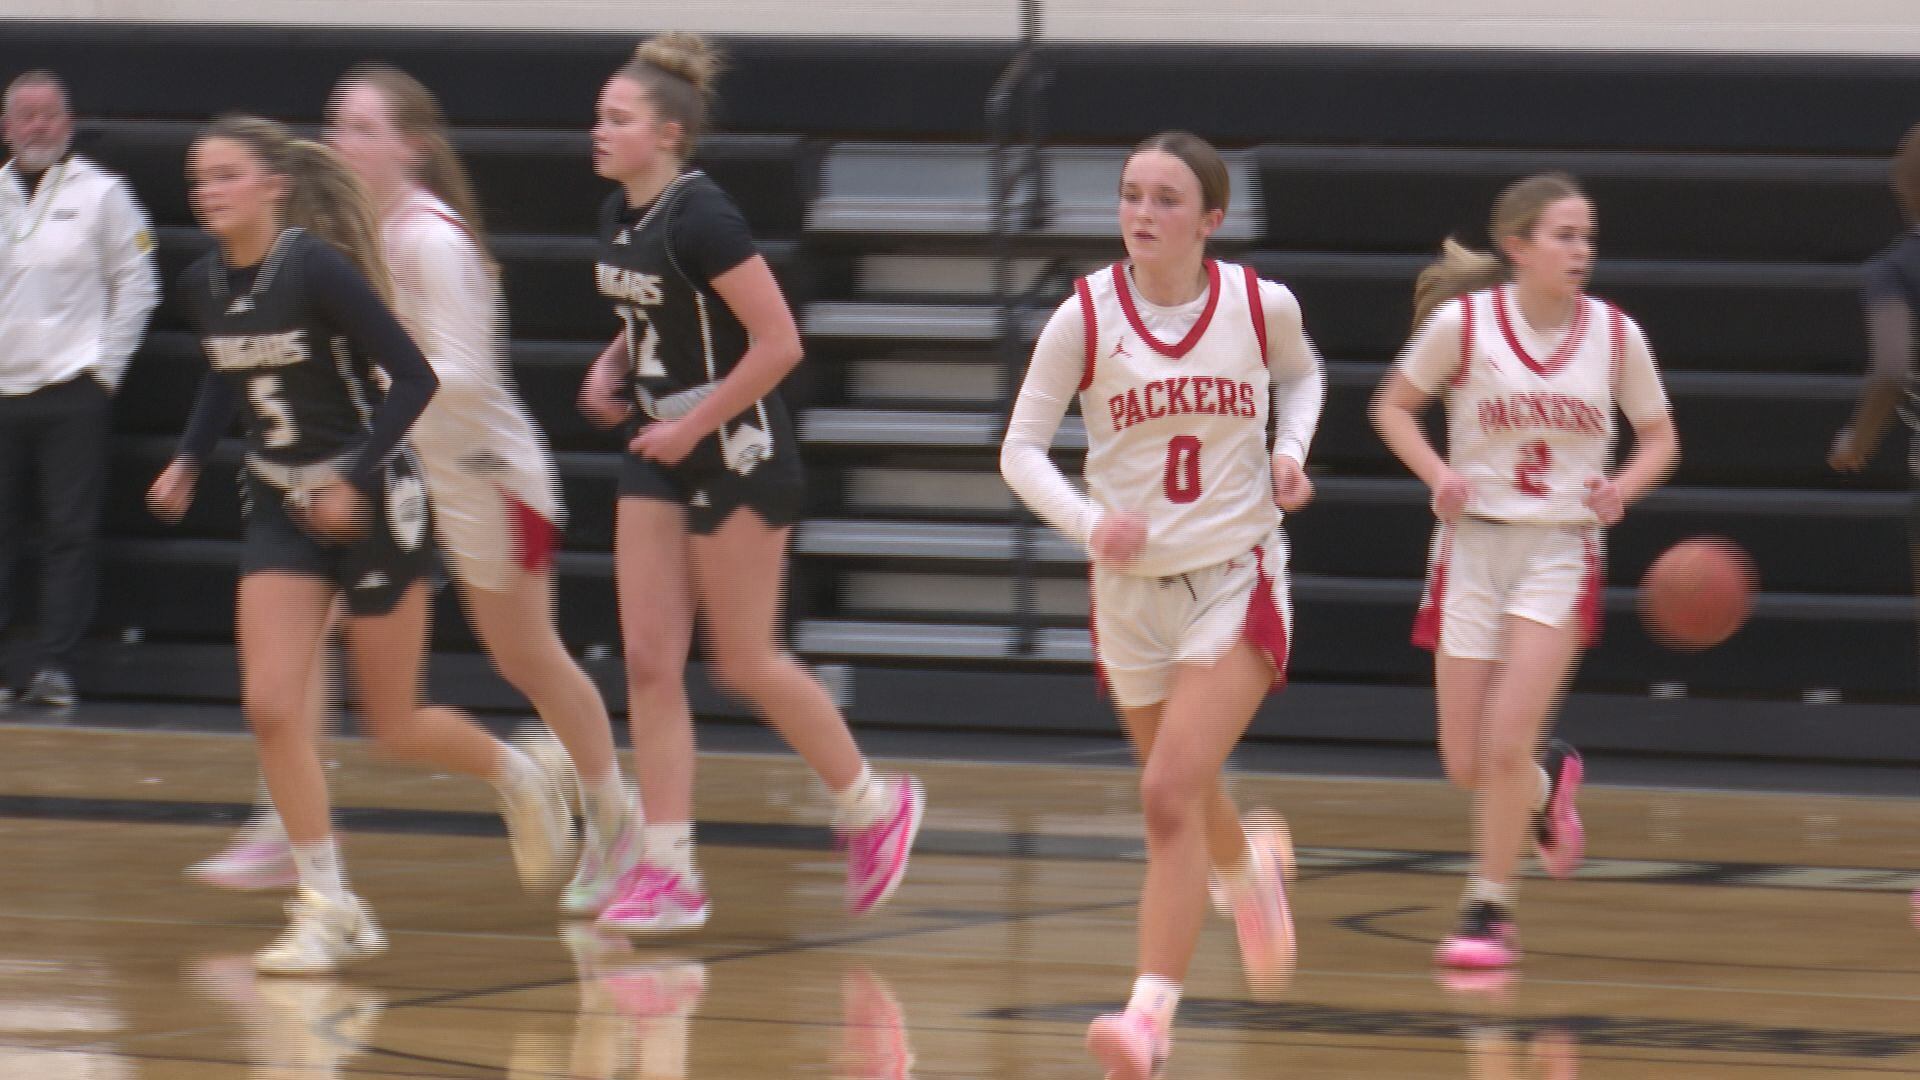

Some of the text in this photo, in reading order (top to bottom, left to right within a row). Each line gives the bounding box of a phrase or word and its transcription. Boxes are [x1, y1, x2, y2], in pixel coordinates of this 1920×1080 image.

[612, 305, 668, 377] 12
[246, 376, 301, 447] 5
[1108, 376, 1256, 431] PACKERS
[1478, 391, 1606, 434] PACKERS
[1164, 435, 1203, 504] 0
[1513, 439, 1552, 498] 2
